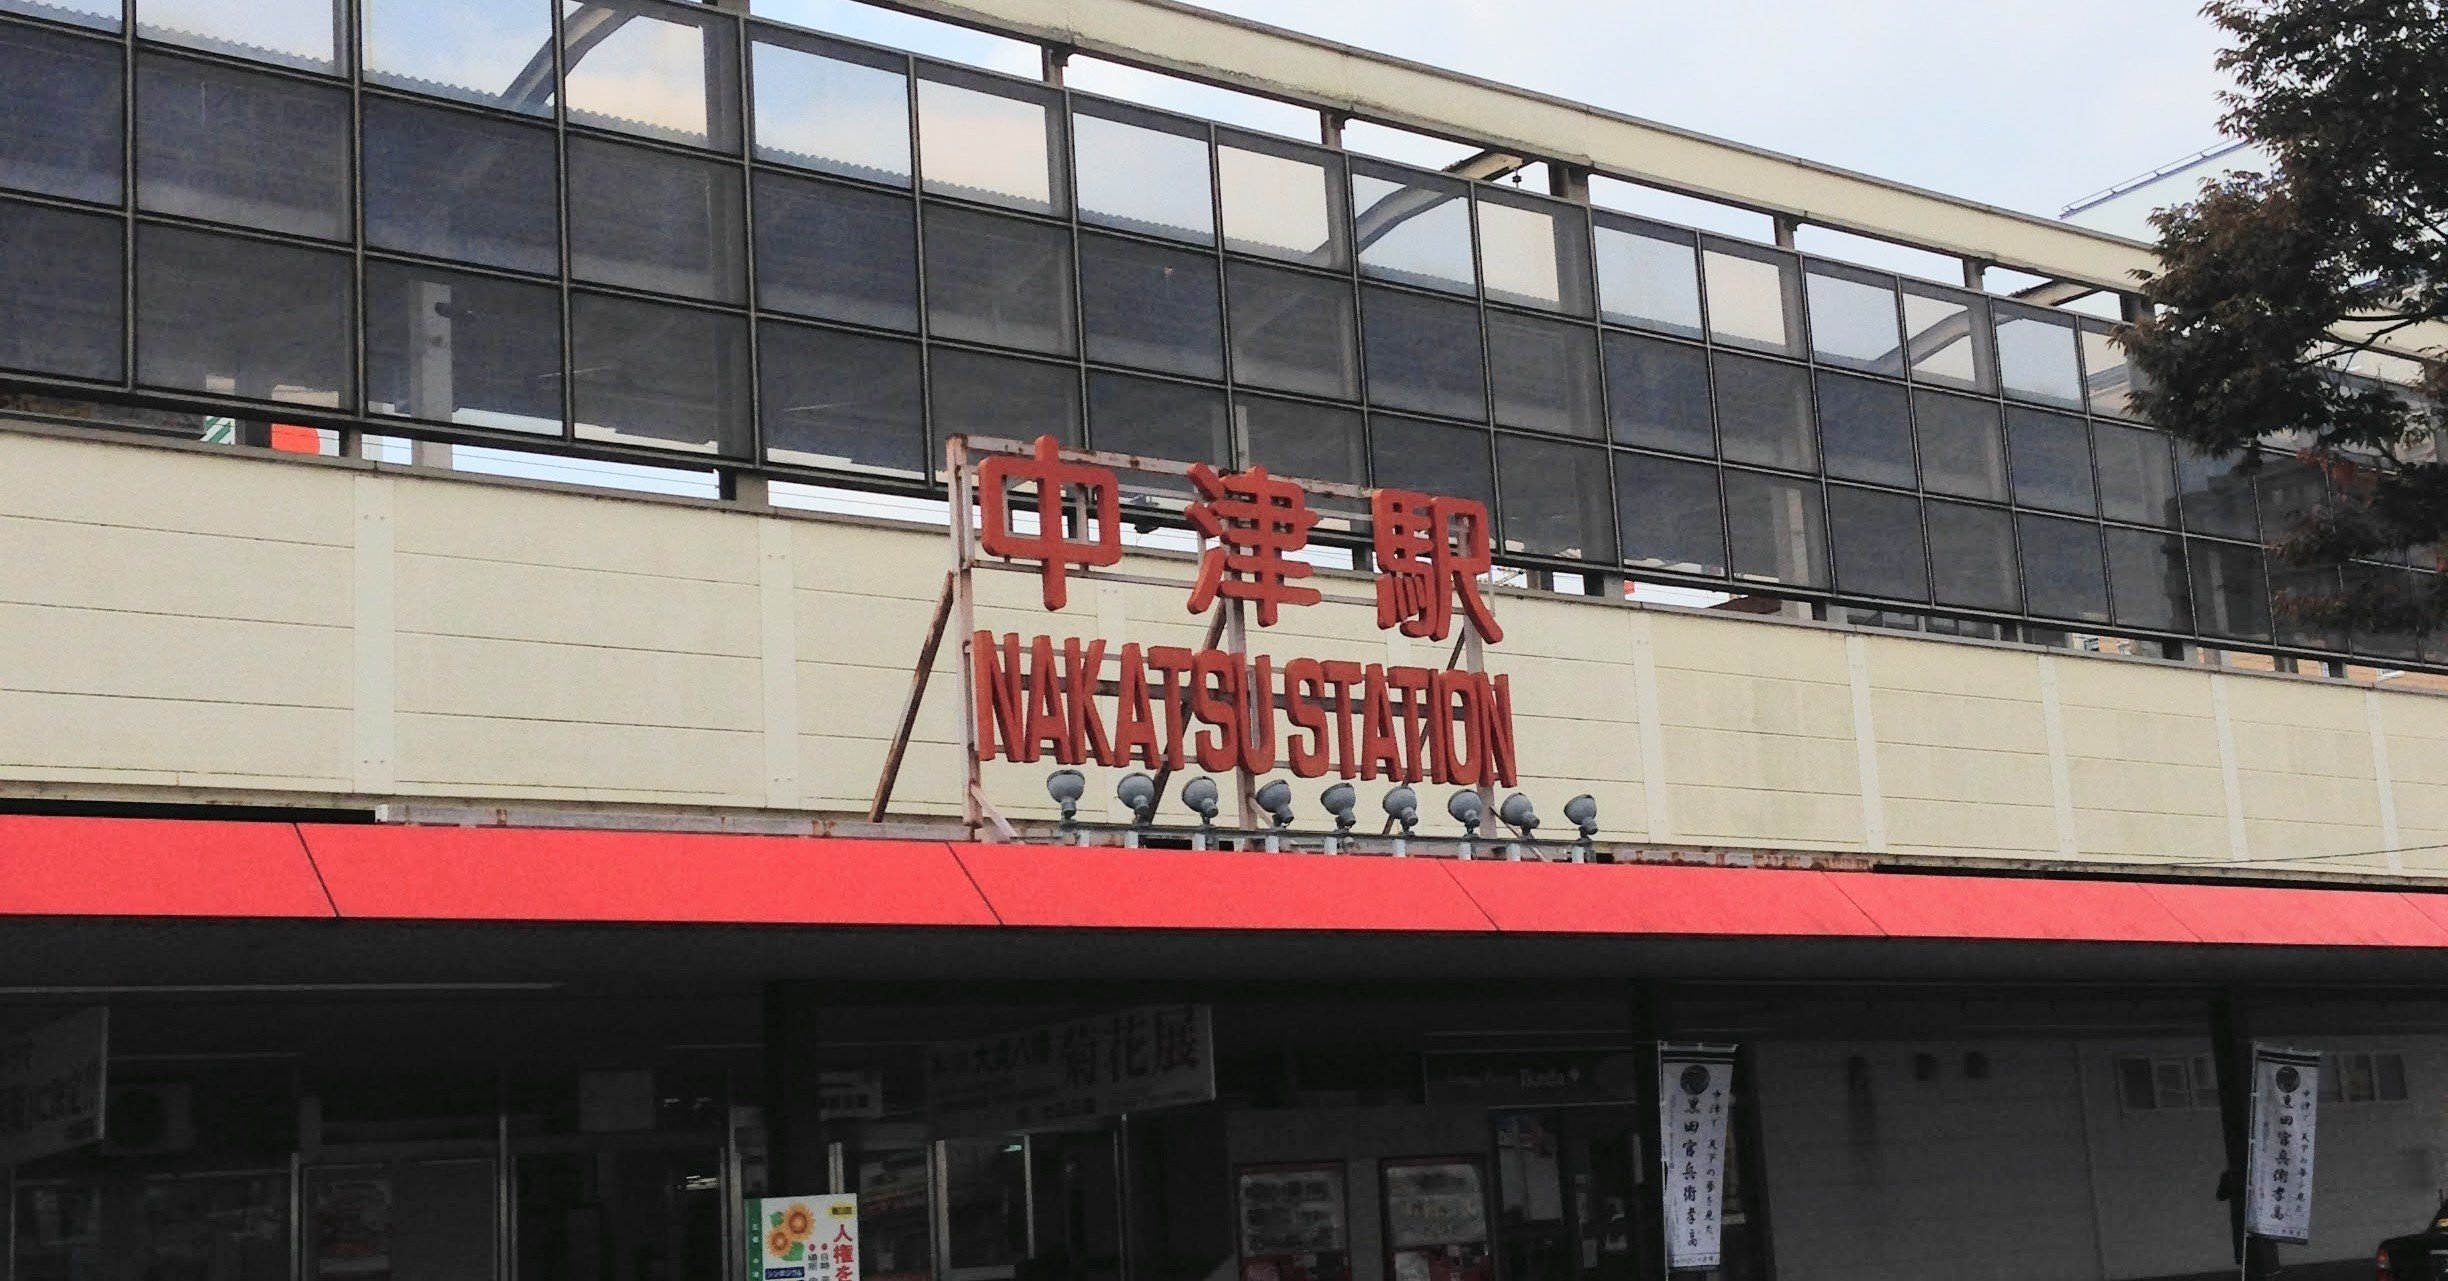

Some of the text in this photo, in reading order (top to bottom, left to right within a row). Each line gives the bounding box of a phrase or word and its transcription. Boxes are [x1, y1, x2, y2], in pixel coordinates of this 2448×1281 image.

[977, 434, 1503, 644] 中津駅
[972, 629, 1518, 788] NAKATSU STATION
